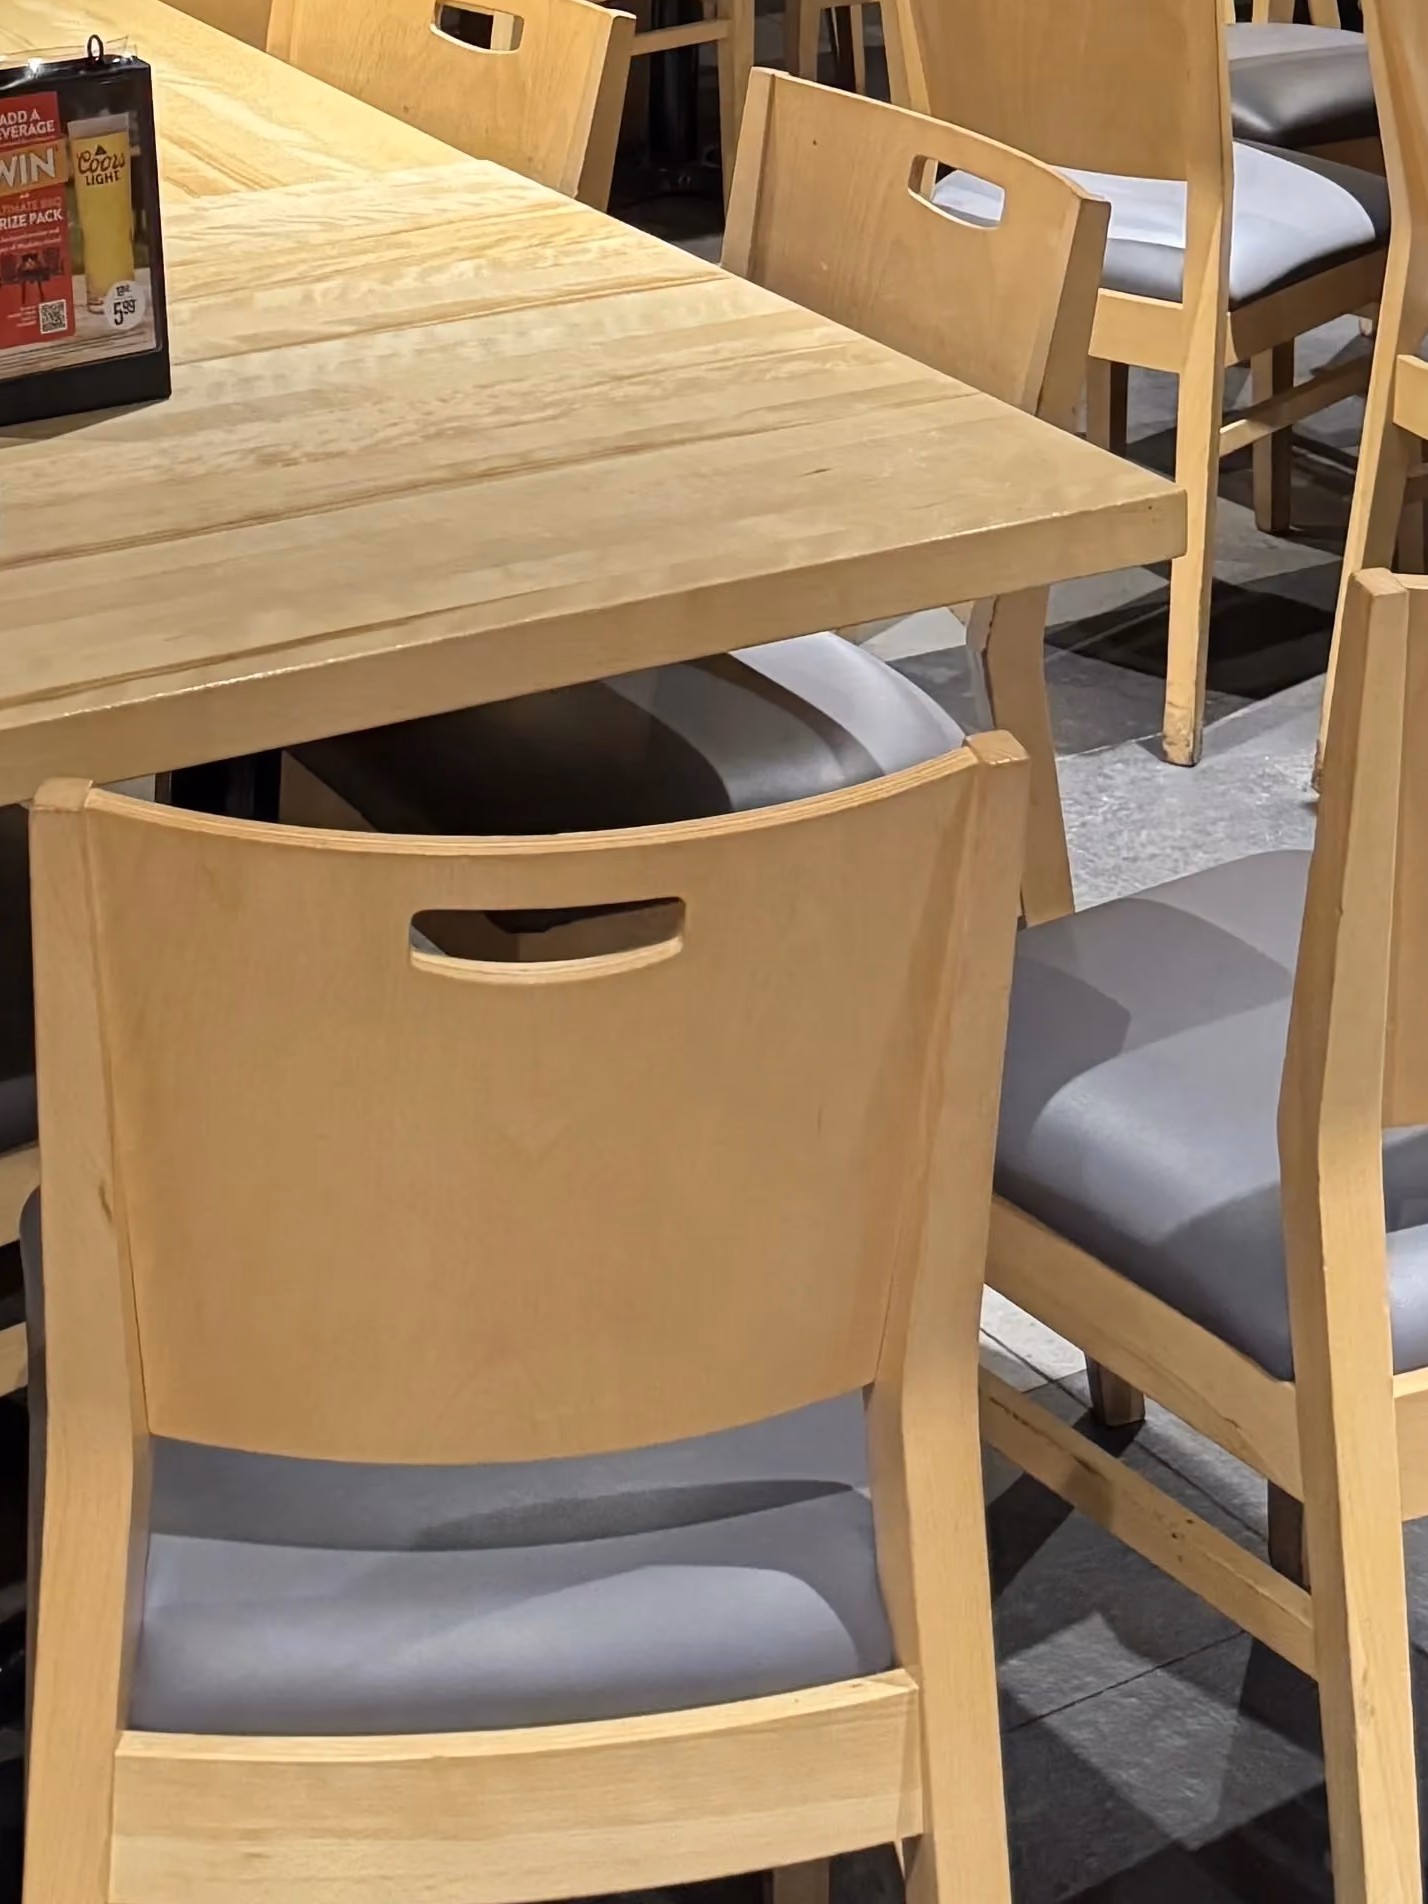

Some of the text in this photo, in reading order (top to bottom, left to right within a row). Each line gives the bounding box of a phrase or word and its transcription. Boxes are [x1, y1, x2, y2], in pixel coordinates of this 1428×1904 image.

[30, 108, 41, 122] A
[76, 150, 125, 174] Coors
[85, 170, 120, 186] LIGHT
[29, 208, 63, 225] PACK
